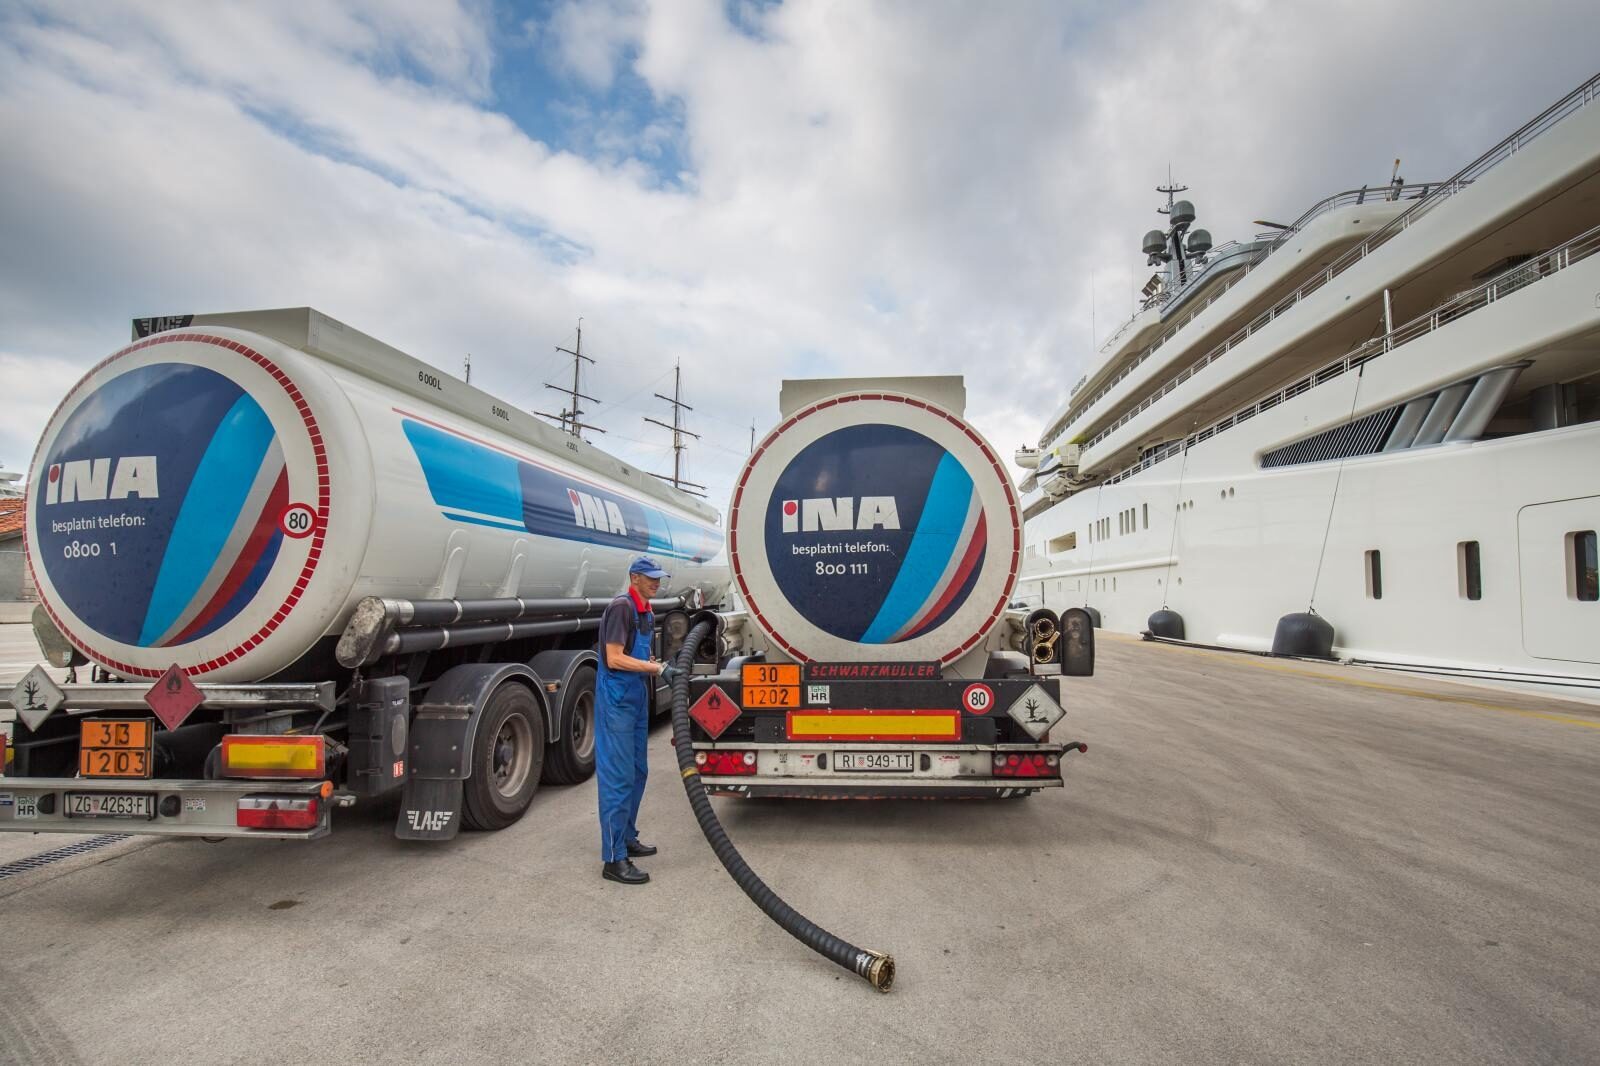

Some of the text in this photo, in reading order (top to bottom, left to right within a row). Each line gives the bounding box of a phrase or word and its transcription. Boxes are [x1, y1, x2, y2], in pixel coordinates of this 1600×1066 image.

[46, 456, 159, 505] INA
[289, 512, 308, 529] 80
[566, 488, 627, 536] INA
[783, 496, 900, 533] INA
[52, 513, 146, 535] besplatni telefon:
[64, 541, 117, 558] 0800 1
[792, 541, 889, 557] besplatni telefon:
[815, 561, 868, 575] 800 111
[759, 667, 778, 683] 30
[750, 689, 789, 705] 1202
[811, 693, 827, 701] HR
[971, 692, 986, 706] 80
[86, 752, 144, 773] 1203
[843, 755, 855, 768] RI
[18, 805, 35, 815] HR
[75, 796, 91, 813] ZG
[411, 811, 444, 830] LAG
